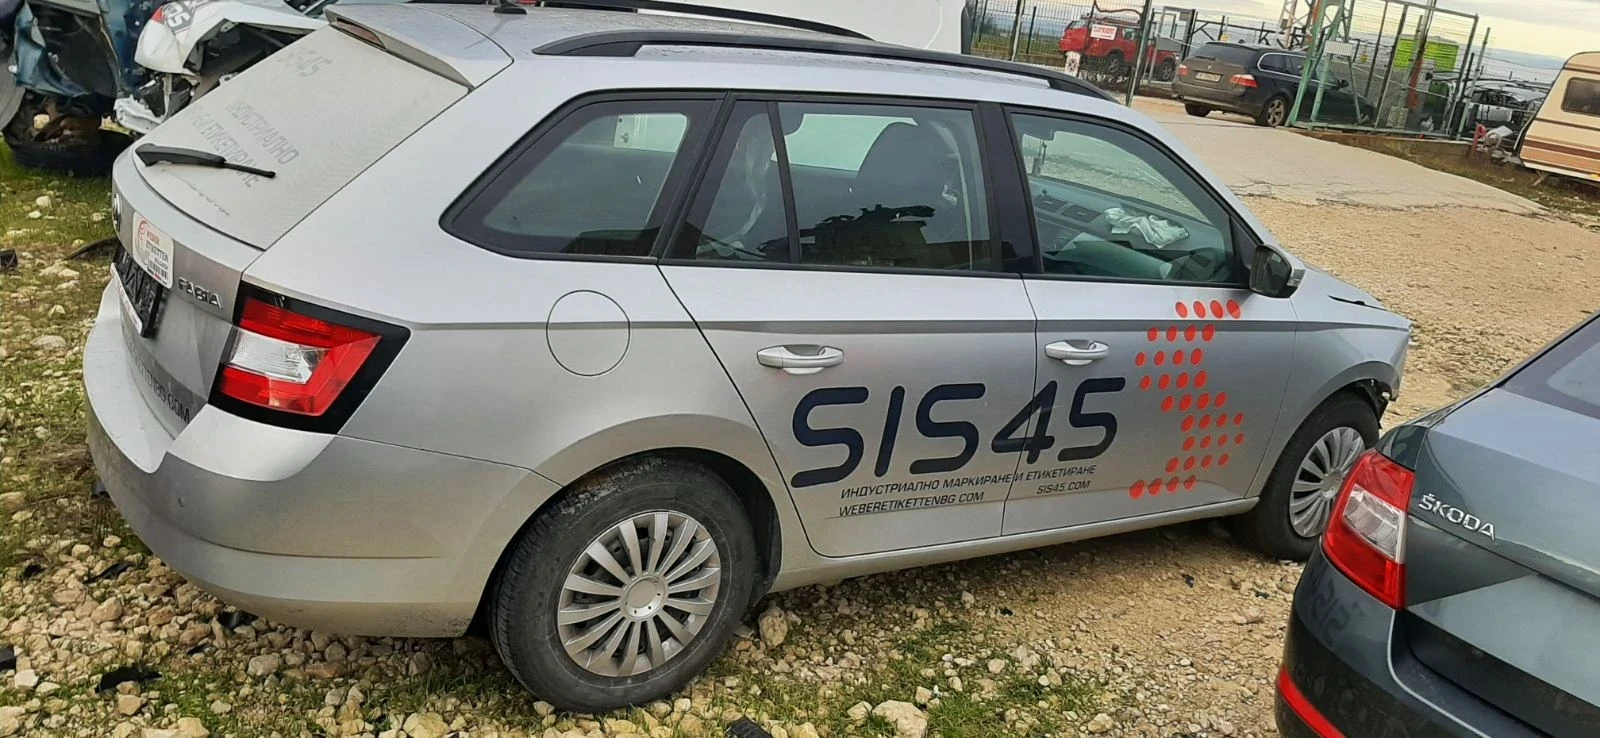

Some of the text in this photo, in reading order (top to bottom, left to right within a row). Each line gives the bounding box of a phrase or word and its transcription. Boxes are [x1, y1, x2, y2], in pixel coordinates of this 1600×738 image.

[178, 276, 222, 309] FABIA
[790, 376, 1126, 489] SIS45
[841, 464, 1097, 499] ИНДУСТРИАЛНО МАРКИРАНЕ И ЕТИКЕТИРАНЕ
[1417, 492, 1496, 541] ŠKODA
